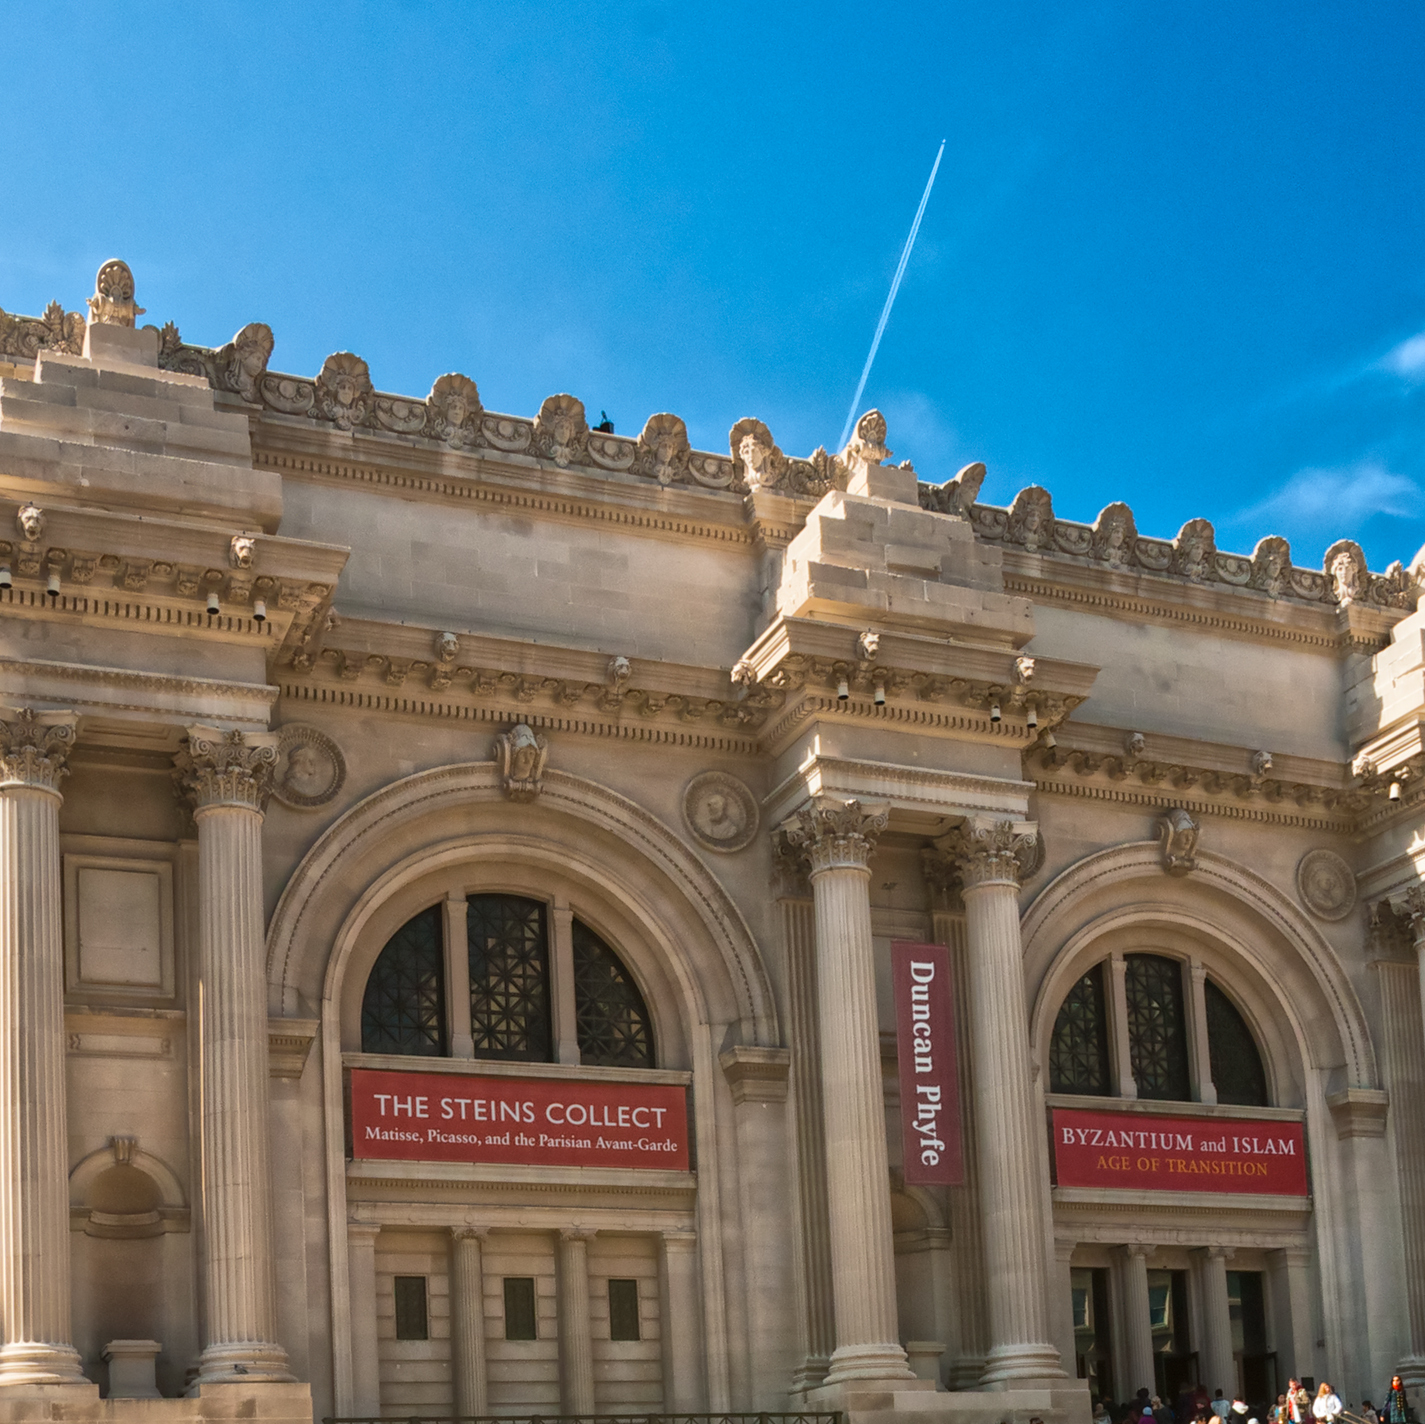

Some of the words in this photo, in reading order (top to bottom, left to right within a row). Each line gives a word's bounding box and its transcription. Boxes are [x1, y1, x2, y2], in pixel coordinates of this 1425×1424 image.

[910, 960, 935, 1073] Duncan
[373, 1093, 429, 1118] THE
[440, 1098, 535, 1124] STEINS
[545, 1103, 667, 1129] COLLECT
[912, 1084, 945, 1166] Phyfe
[365, 1126, 424, 1144] Matisse,
[427, 1128, 482, 1147] Picasso,
[484, 1131, 511, 1146] and
[514, 1133, 536, 1147] the
[539, 1133, 592, 1149] Parisian
[595, 1136, 678, 1152] Avant-Garde
[1062, 1127, 1194, 1151] BYZANTIUM
[1200, 1136, 1226, 1153] and
[1233, 1136, 1296, 1155] ISLAM
[1097, 1155, 1131, 1171] AGE
[1137, 1157, 1160, 1172] OF
[1165, 1158, 1268, 1176] TRANSITION
